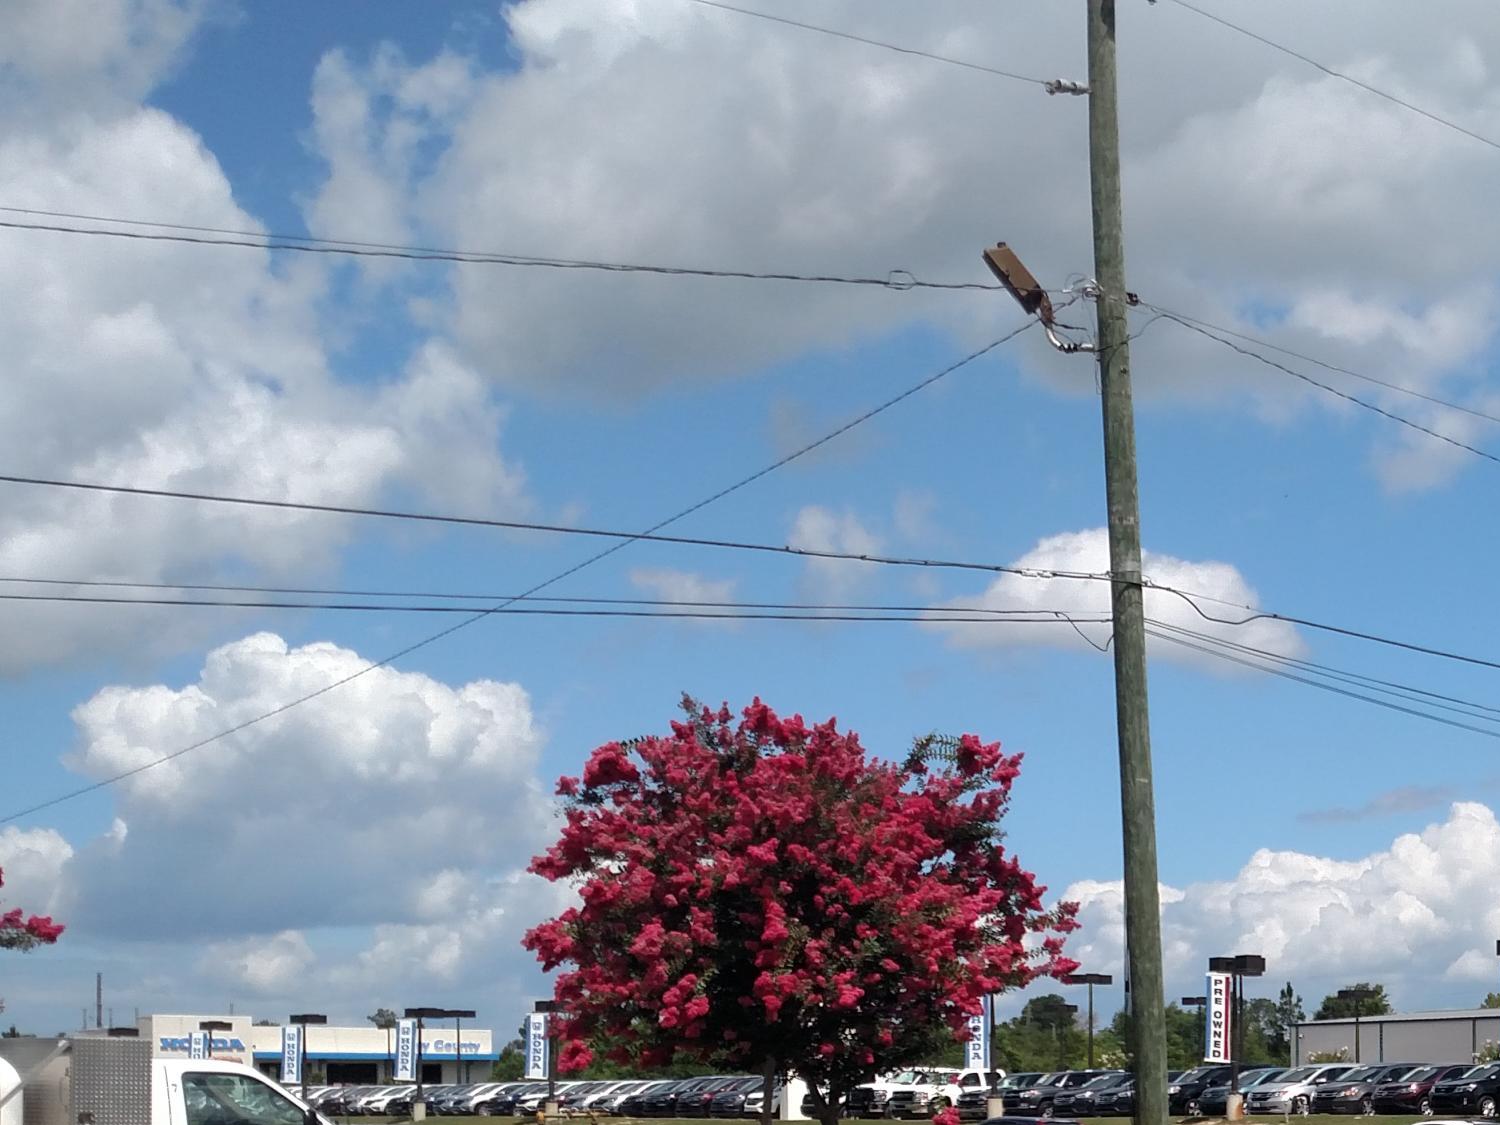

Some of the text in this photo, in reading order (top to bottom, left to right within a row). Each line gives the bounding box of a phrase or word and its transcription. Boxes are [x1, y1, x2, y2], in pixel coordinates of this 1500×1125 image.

[1212, 978, 1224, 1058] PRE OWNED
[159, 1037, 246, 1052] HODA
